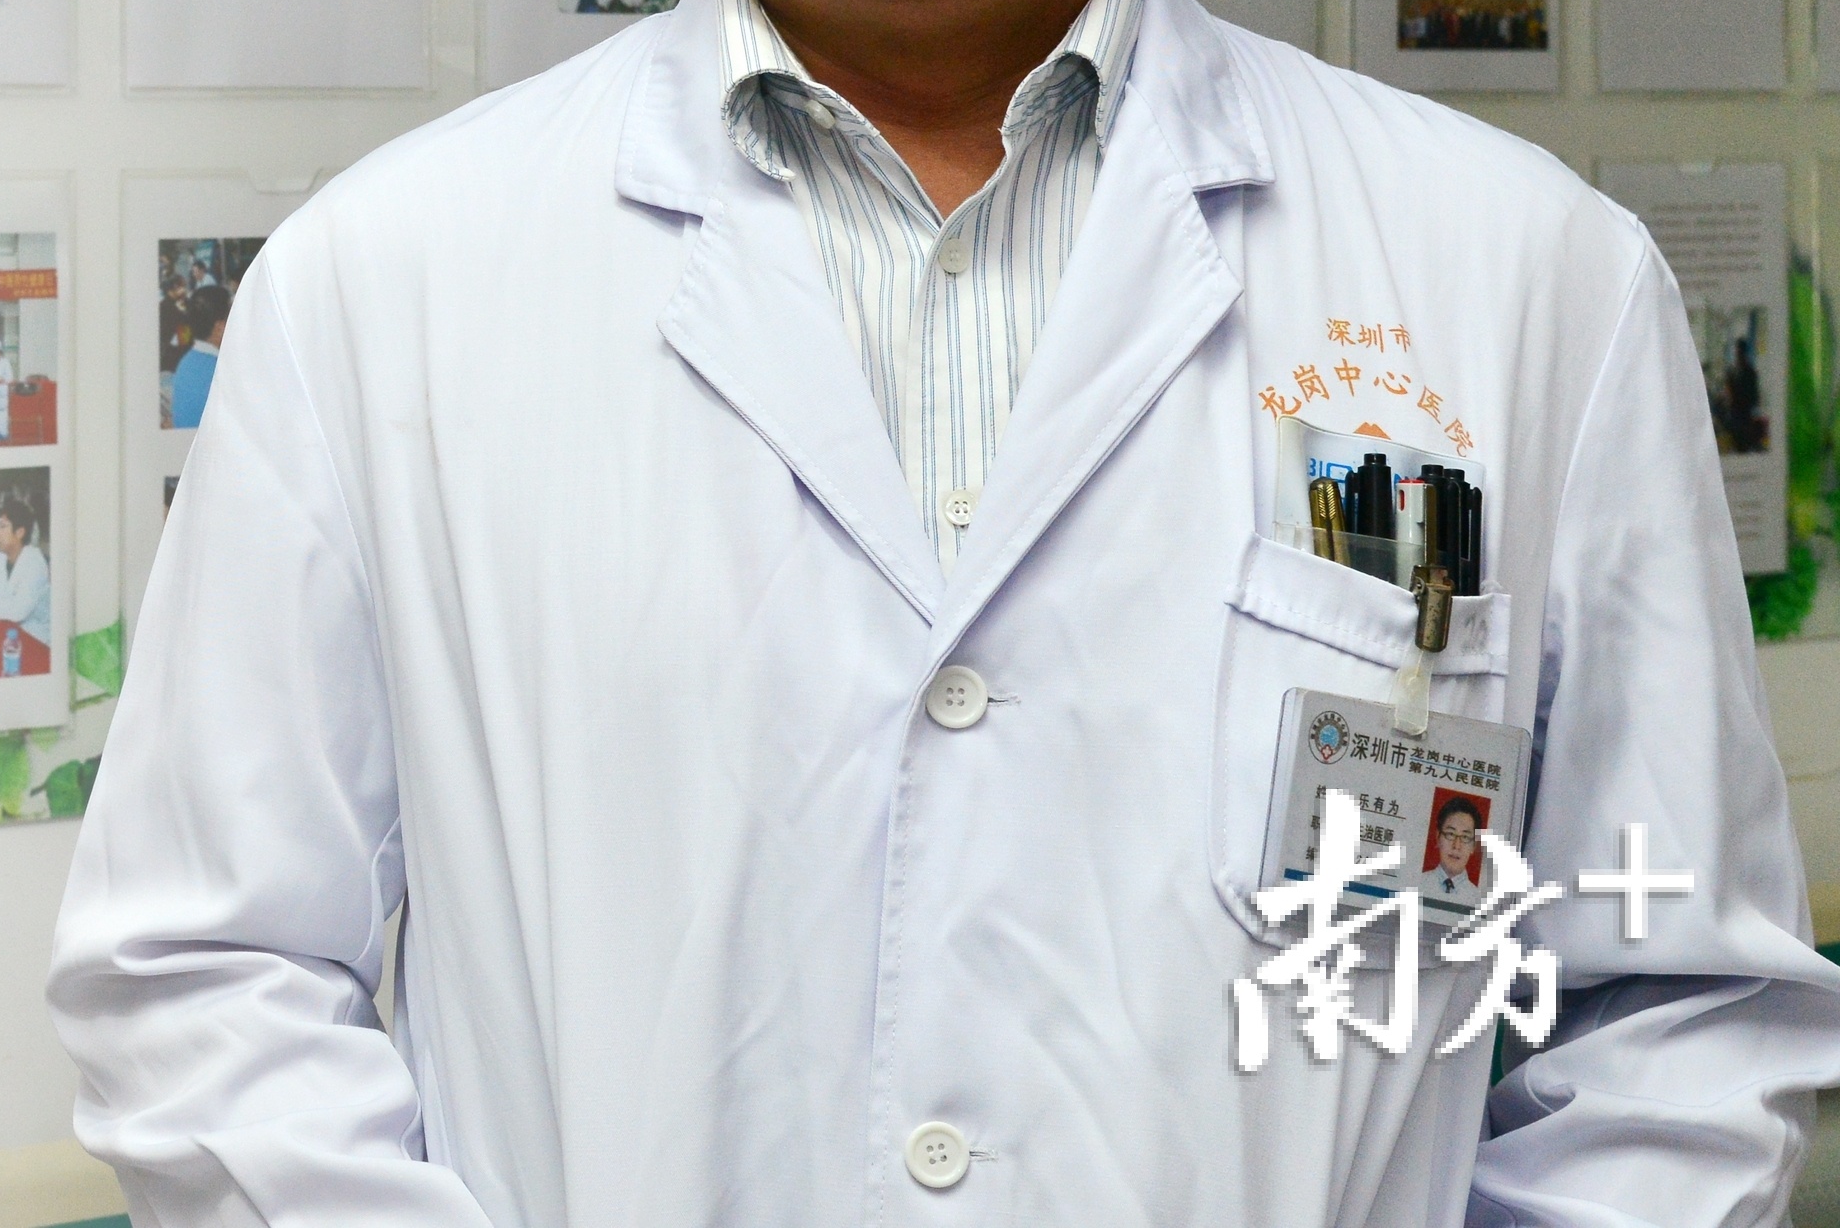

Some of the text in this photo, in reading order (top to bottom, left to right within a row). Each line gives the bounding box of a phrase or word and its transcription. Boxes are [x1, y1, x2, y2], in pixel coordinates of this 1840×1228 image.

[1326, 317, 1411, 354] 深圳市
[1258, 357, 1474, 458] 龙岗中心医院
[1350, 732, 1502, 777] 深圳市 龙岗中心医院
[1408, 761, 1501, 792] 第九人民医院
